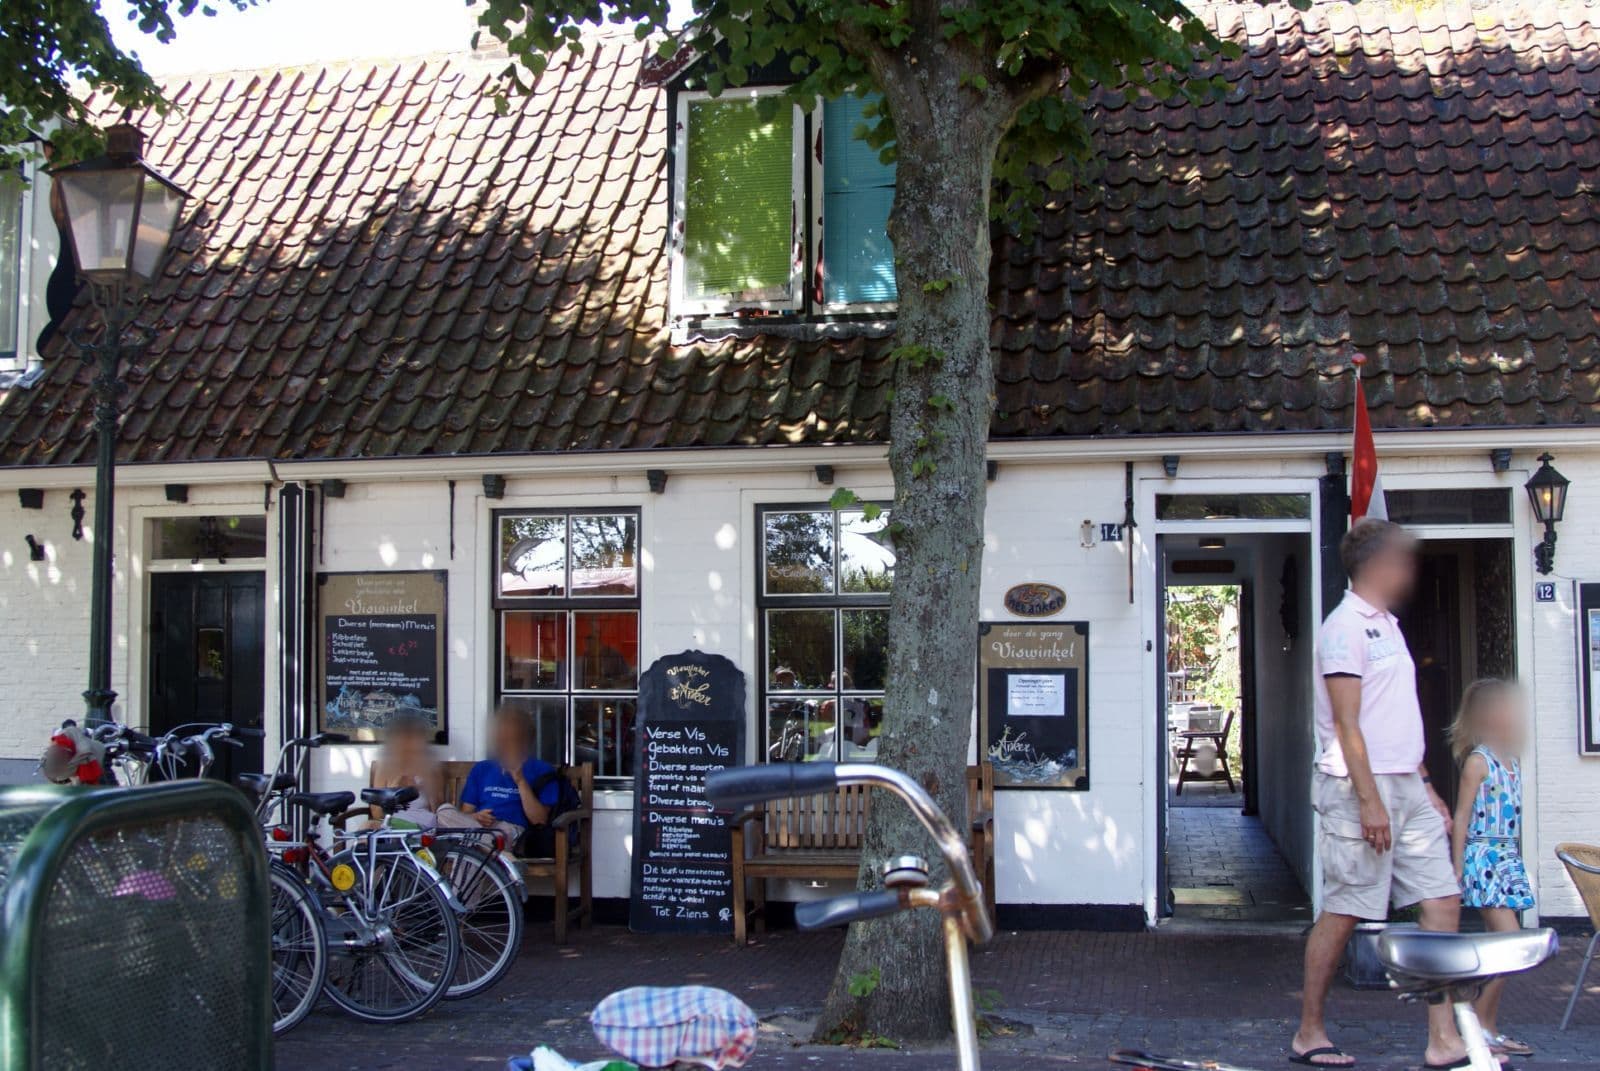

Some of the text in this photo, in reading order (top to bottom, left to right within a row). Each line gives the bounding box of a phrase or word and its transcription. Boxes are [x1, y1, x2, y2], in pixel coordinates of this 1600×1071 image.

[1102, 525, 1120, 540] 14
[1540, 585, 1553, 599] 12
[344, 599, 418, 615] Viswinkel
[338, 618, 367, 628] Diverse
[332, 633, 368, 642] Kibbeling
[1002, 629, 1064, 641] door de gang
[991, 641, 1075, 662] Viswinkel
[666, 662, 711, 678] Viswinkel
[646, 726, 706, 741] Verse Vis
[706, 743, 730, 757] Vis
[649, 760, 725, 771] Diverse soorten
[649, 773, 684, 783] gerookte
[685, 774, 698, 782] vis
[649, 783, 669, 792] forel
[670, 784, 681, 792] of
[649, 794, 685, 806] Diverse
[649, 811, 725, 826] Diverse menu's
[643, 863, 659, 875] Dit
[661, 866, 678, 875] kunt
[685, 867, 726, 877] meenemen
[642, 893, 667, 901] achter
[679, 896, 706, 904] winkel
[674, 888, 682, 896] op
[685, 887, 698, 895] ons
[700, 887, 726, 897] terras
[651, 905, 710, 919] Tot Ziens
